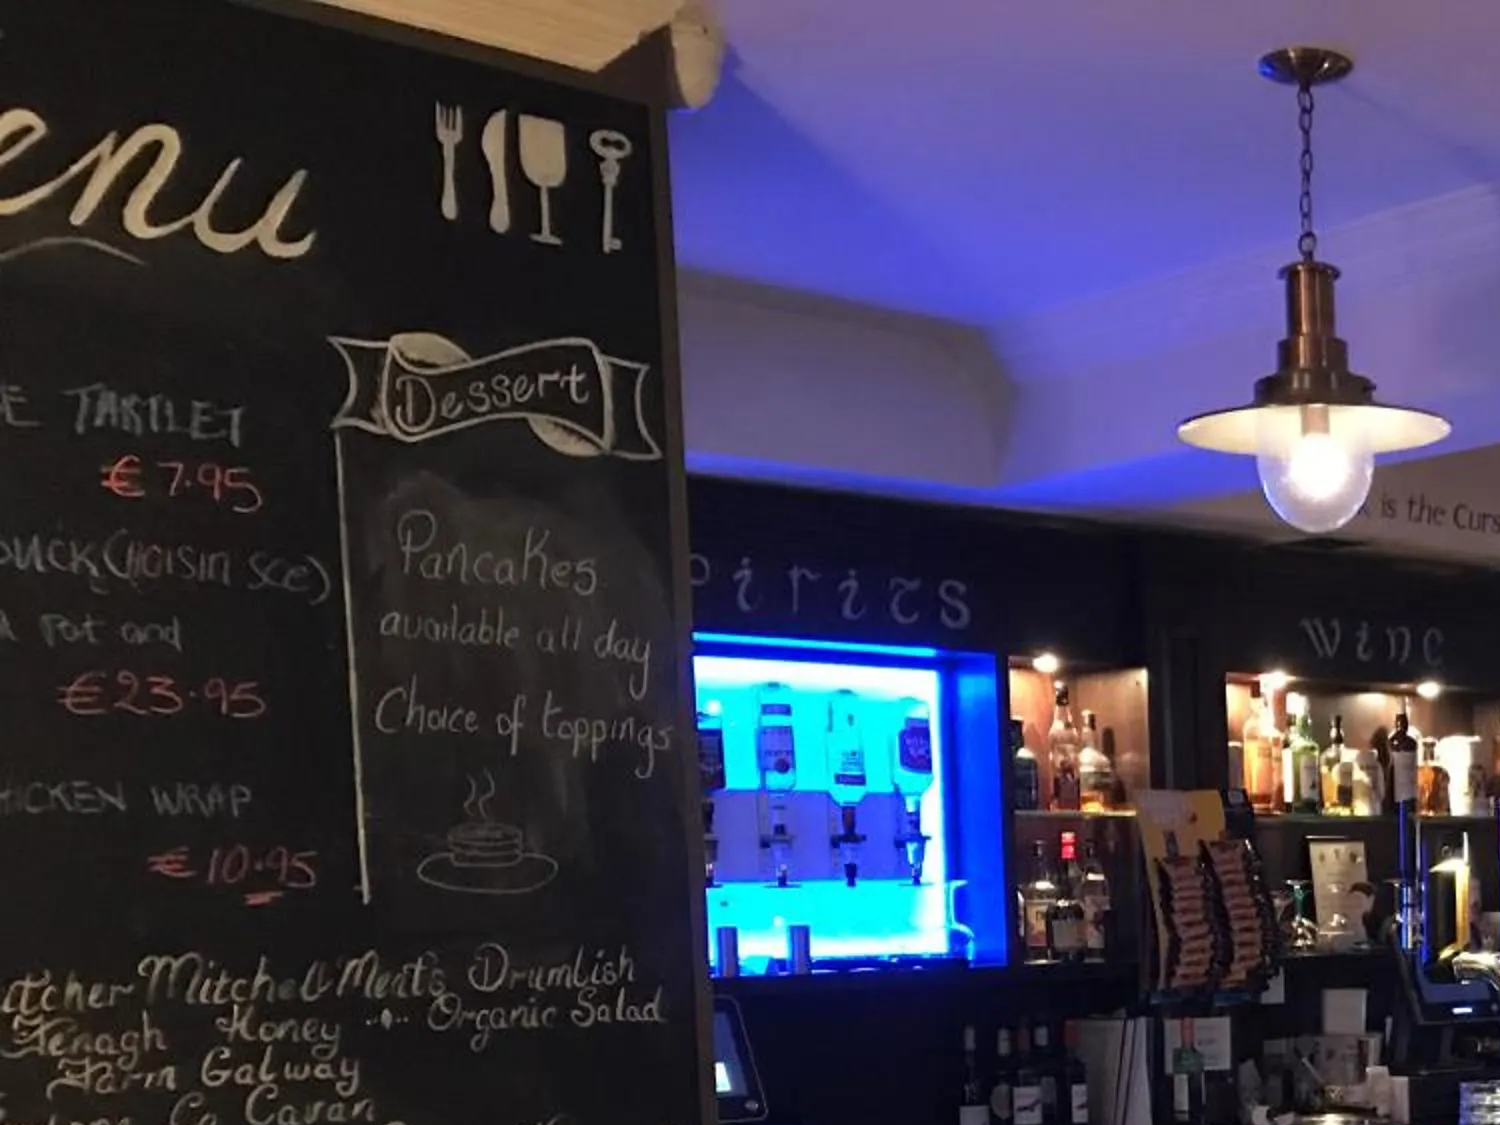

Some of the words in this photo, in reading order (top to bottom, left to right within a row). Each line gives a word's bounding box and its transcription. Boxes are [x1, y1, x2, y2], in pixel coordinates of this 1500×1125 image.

[395, 363, 591, 433] Dessert
[1382, 493, 1399, 520] is
[1407, 492, 1448, 527] the
[378, 602, 522, 648] available
[536, 613, 584, 652] all
[592, 617, 652, 701] day
[1299, 617, 1447, 669] Wine
[374, 672, 480, 736] Choice
[494, 692, 528, 757] of
[542, 690, 675, 780] toppings
[151, 782, 253, 819] WRAP
[570, 984, 668, 1028] Salad
[200, 1046, 361, 1097] Galway
